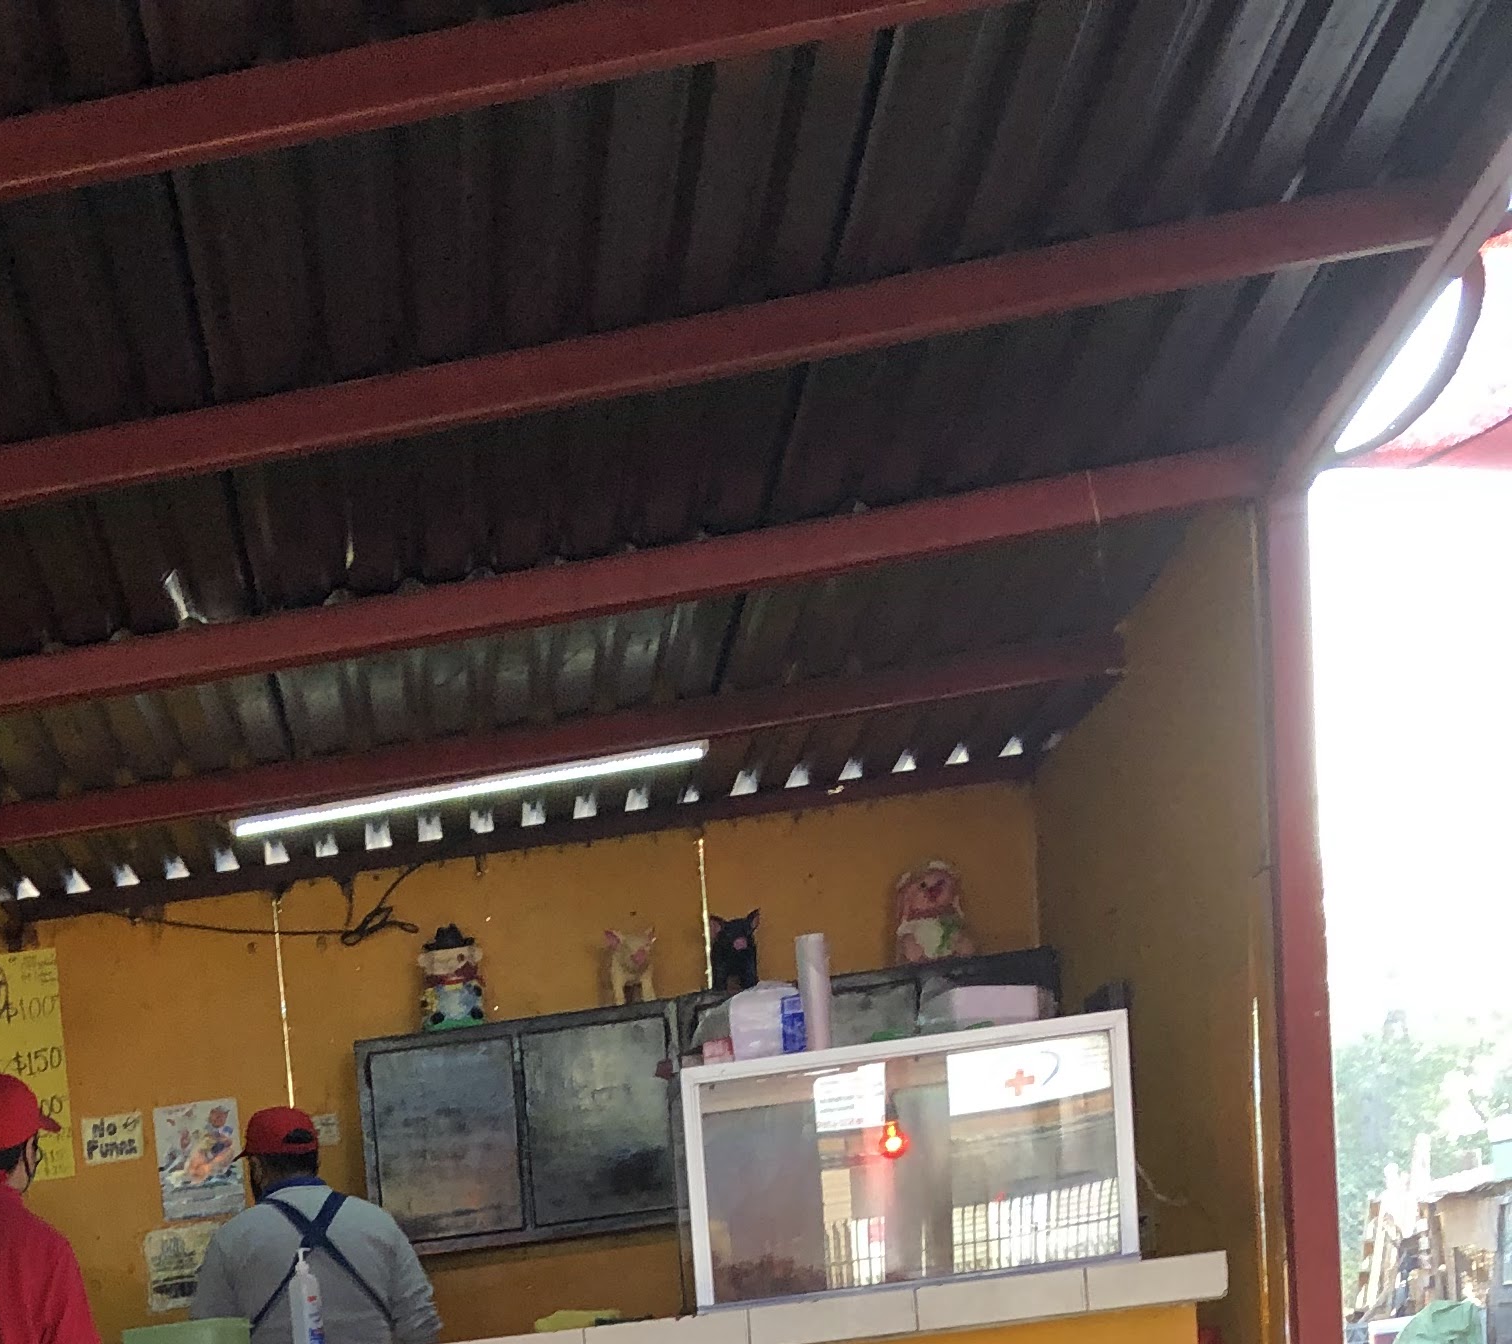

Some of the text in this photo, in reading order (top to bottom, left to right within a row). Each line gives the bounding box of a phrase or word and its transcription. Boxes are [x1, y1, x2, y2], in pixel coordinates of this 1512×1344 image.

[13, 1046, 63, 1076] $150
[91, 1117, 118, 1139] No
[86, 1138, 138, 1161] Fumar
